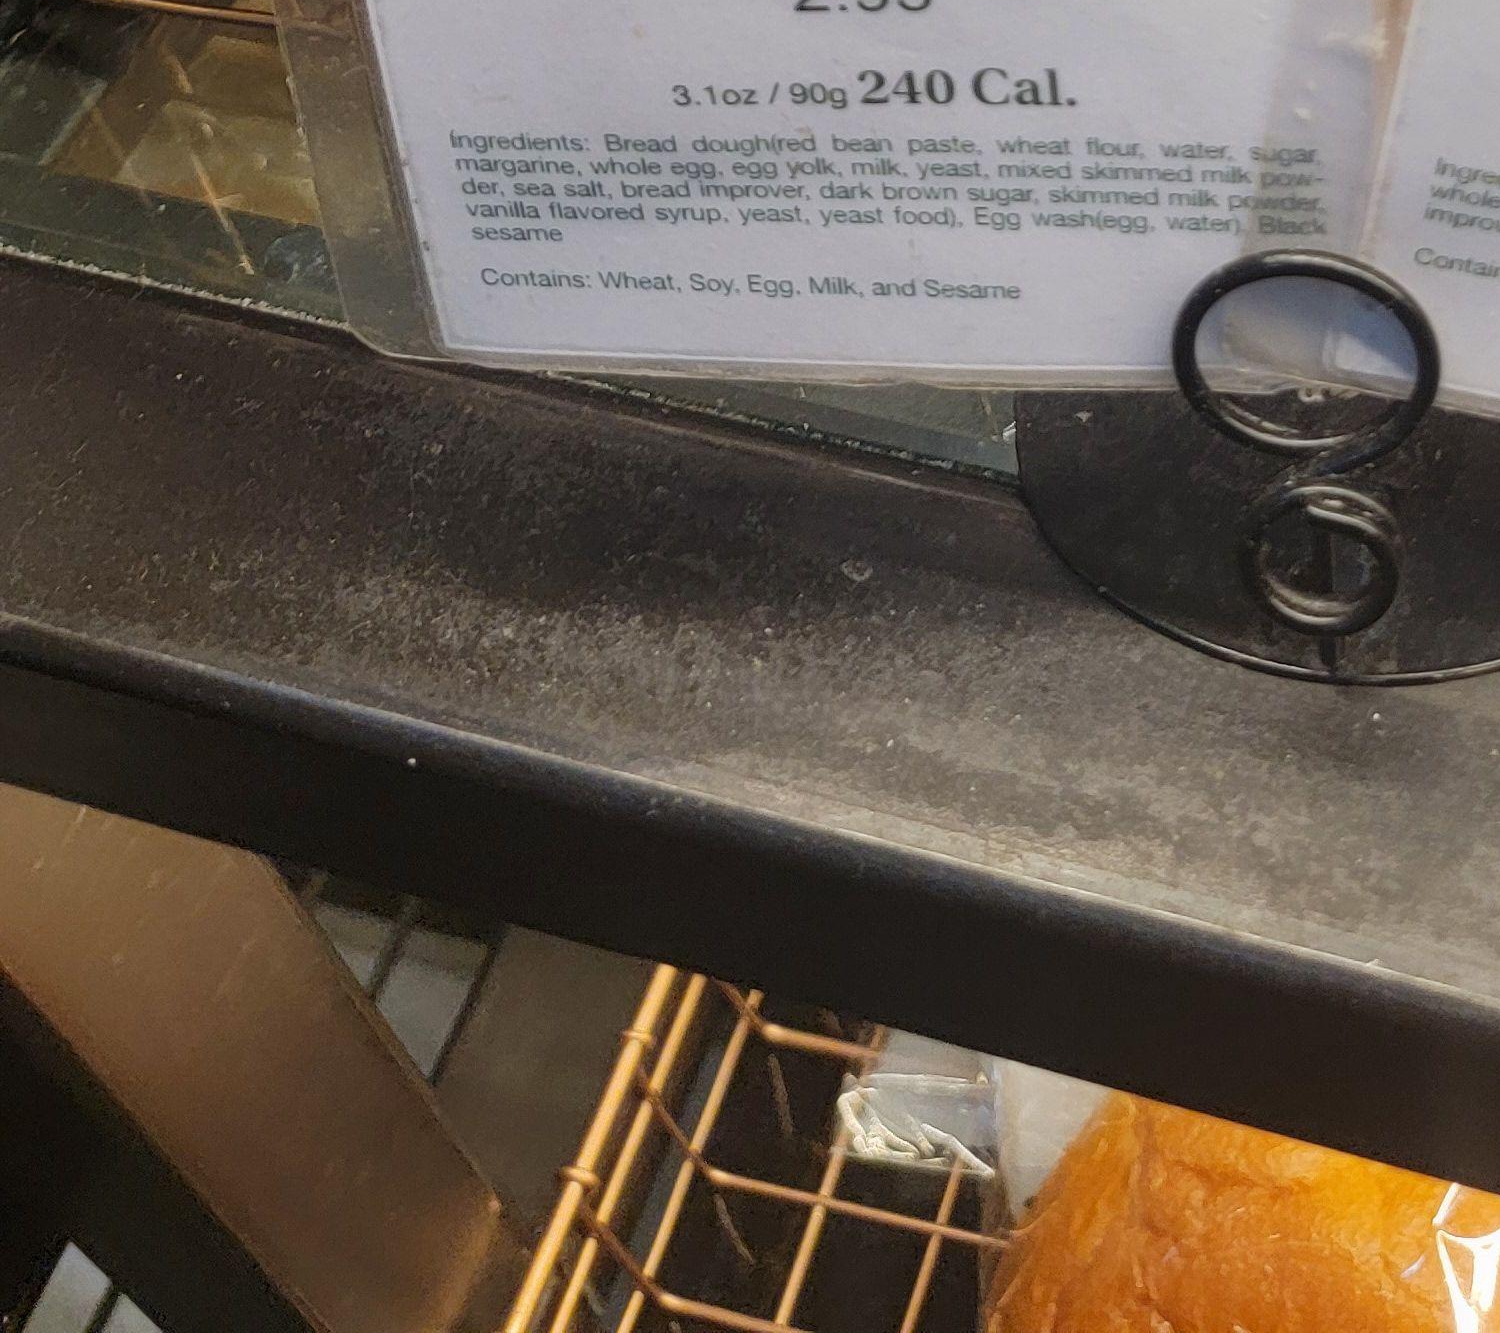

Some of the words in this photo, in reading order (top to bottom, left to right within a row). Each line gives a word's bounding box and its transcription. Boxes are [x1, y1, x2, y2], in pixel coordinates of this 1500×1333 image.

[672, 83, 760, 108] 3.1oz
[767, 80, 781, 106] /
[788, 82, 849, 111] 90g
[857, 68, 957, 106] 240
[971, 66, 1080, 107] Cal.
[450, 130, 591, 154] Ingredients:
[603, 133, 678, 154] Bread
[691, 133, 816, 157] dough(red
[832, 133, 893, 153] bean
[907, 134, 983, 156] paste,
[995, 137, 1073, 156] wheat
[1086, 138, 1146, 159] flour,
[1159, 141, 1234, 161] water,
[1250, 145, 1322, 167] sugar,
[455, 156, 583, 177] margarine,
[590, 157, 662, 176] whole
[670, 160, 724, 180] egg,
[732, 160, 778, 180] egg
[786, 158, 843, 179] yolk,
[851, 158, 908, 178] milk,
[917, 160, 990, 181] yeast,
[997, 161, 1073, 179] mixed
[1081, 162, 1193, 183] skimmed
[1201, 165, 1251, 183] milk
[1261, 170, 1325, 188] pow-
[461, 177, 505, 197] der,
[513, 183, 556, 197] sea
[564, 181, 613, 199] salt,
[620, 181, 691, 199] bread
[700, 182, 811, 202] improver,
[820, 182, 874, 200] dark
[882, 183, 958, 201] brown
[967, 186, 1040, 206] sugar,
[1048, 186, 1160, 206] skimmed
[1168, 188, 1219, 208] milk
[1228, 192, 1327, 212] powder,
[466, 200, 541, 219] vanilla
[549, 202, 645, 221] flavored
[655, 205, 729, 225] syrup,
[738, 205, 811, 226] yeast,
[819, 206, 883, 226] yeast
[894, 205, 964, 229] food),
[974, 206, 1022, 230] Egg
[1031, 209, 1156, 234] wash(egg,
[1258, 215, 1328, 235] Black
[471, 225, 564, 242] sesame
[481, 268, 591, 288] Contains:
[598, 271, 682, 292] Wheat,
[688, 273, 740, 297] Soy,
[747, 274, 801, 298] Egg,
[809, 276, 864, 298] Milk,
[872, 279, 917, 297] and
[924, 279, 1021, 300] Sesame
